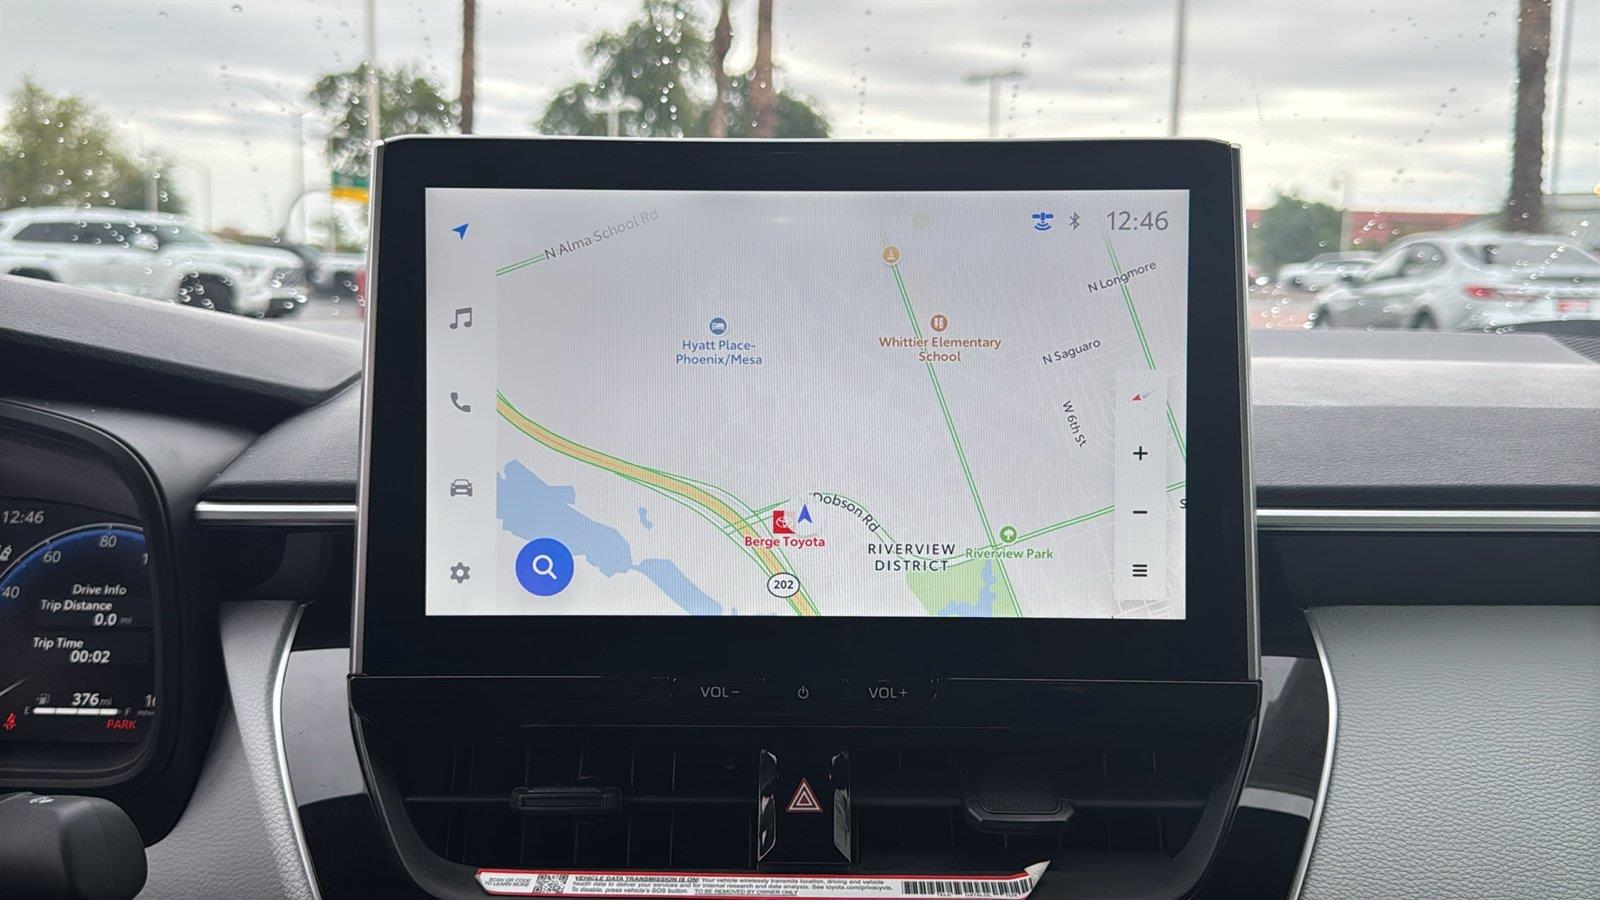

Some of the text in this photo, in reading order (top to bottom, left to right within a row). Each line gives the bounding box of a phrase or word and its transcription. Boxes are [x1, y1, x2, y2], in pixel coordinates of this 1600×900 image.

[1106, 211, 1169, 232] 12:46
[544, 207, 659, 260] N Alma School Rd
[1087, 262, 1157, 293] N Longmore
[682, 340, 756, 352] Hyatt Place-
[879, 337, 1001, 350] Whittier Elementary
[919, 352, 961, 362] School
[1042, 339, 1101, 365] N Saguaro
[675, 354, 762, 366] Phoenix/Mesa
[1062, 400, 1087, 448] W 6th St
[2, 510, 45, 524] 12:46
[862, 513, 881, 532] Rd
[100, 534, 117, 548] 80
[745, 536, 825, 549] Berge Toyota
[868, 544, 955, 555] RIVERVIEW
[965, 548, 1053, 559] Riverview Park
[43, 550, 61, 563] 60
[875, 560, 948, 571] DISTRICT
[72, 584, 127, 595] Drive Info
[773, 580, 794, 590] 202
[2, 586, 20, 598] 40
[41, 599, 113, 612] Trip Distance
[94, 613, 118, 626] 0.0
[33, 636, 84, 650] Trip Time
[70, 650, 111, 663] 00:02
[71, 692, 112, 706] 376 mi
[24, 706, 31, 715] E
[125, 708, 131, 716] F
[106, 719, 137, 730] PARK
